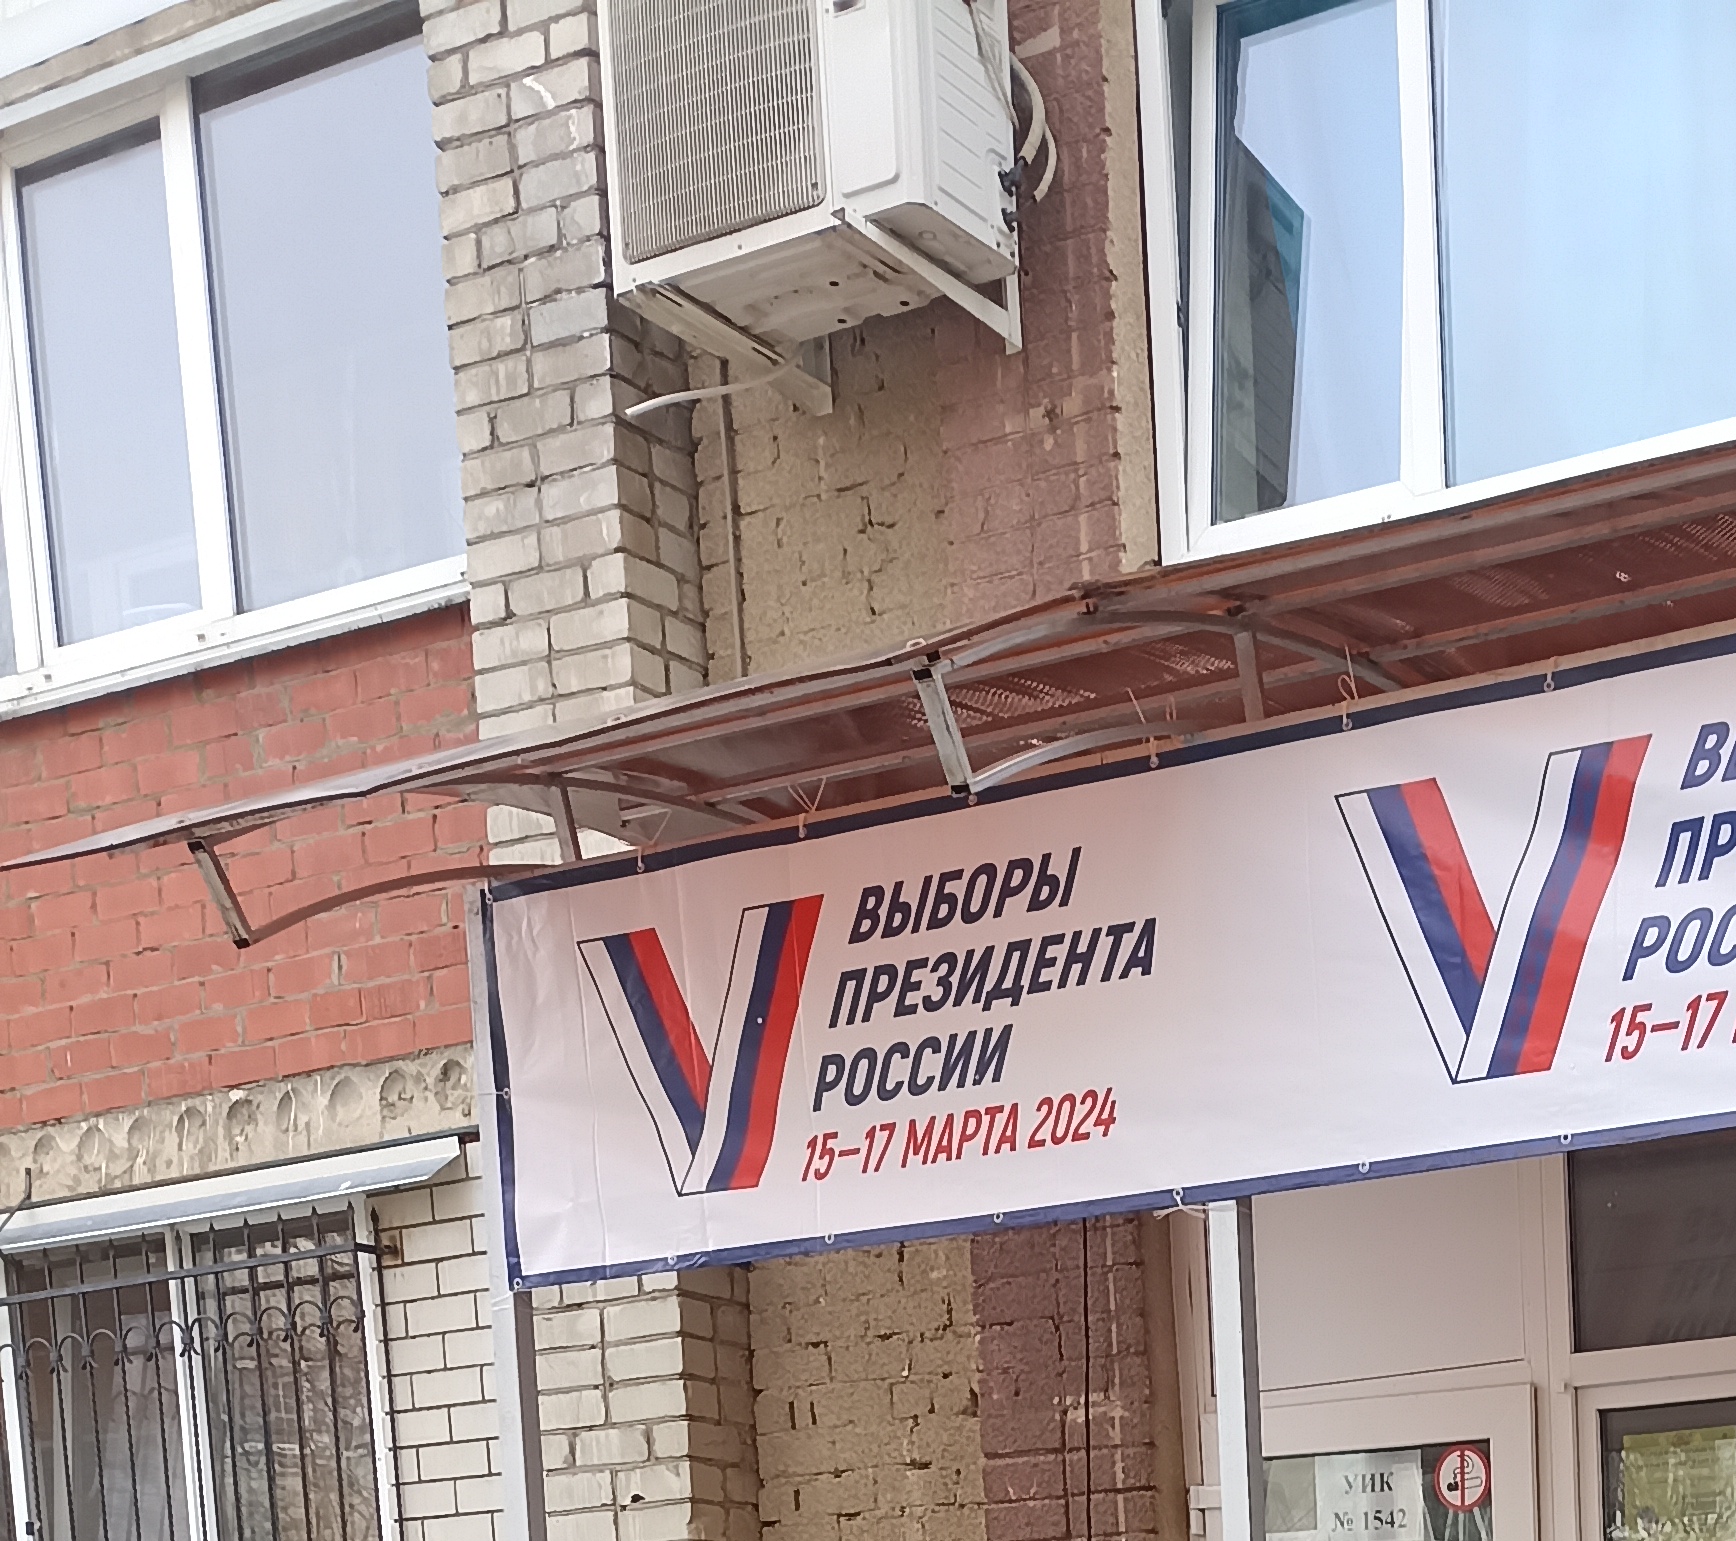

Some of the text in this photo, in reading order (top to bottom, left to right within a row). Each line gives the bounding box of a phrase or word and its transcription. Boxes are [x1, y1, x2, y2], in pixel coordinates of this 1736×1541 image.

[848, 846, 1082, 945] ВЫБОРЫ
[828, 917, 1158, 1029] ПРЕЗИДЕНТА
[812, 1023, 1014, 1112] РОССИИ
[901, 1103, 1018, 1169] МАРТА
[1028, 1086, 1117, 1150] 2024
[1331, 1508, 1407, 1532] № 1542
[1343, 1471, 1393, 1495] УИК
